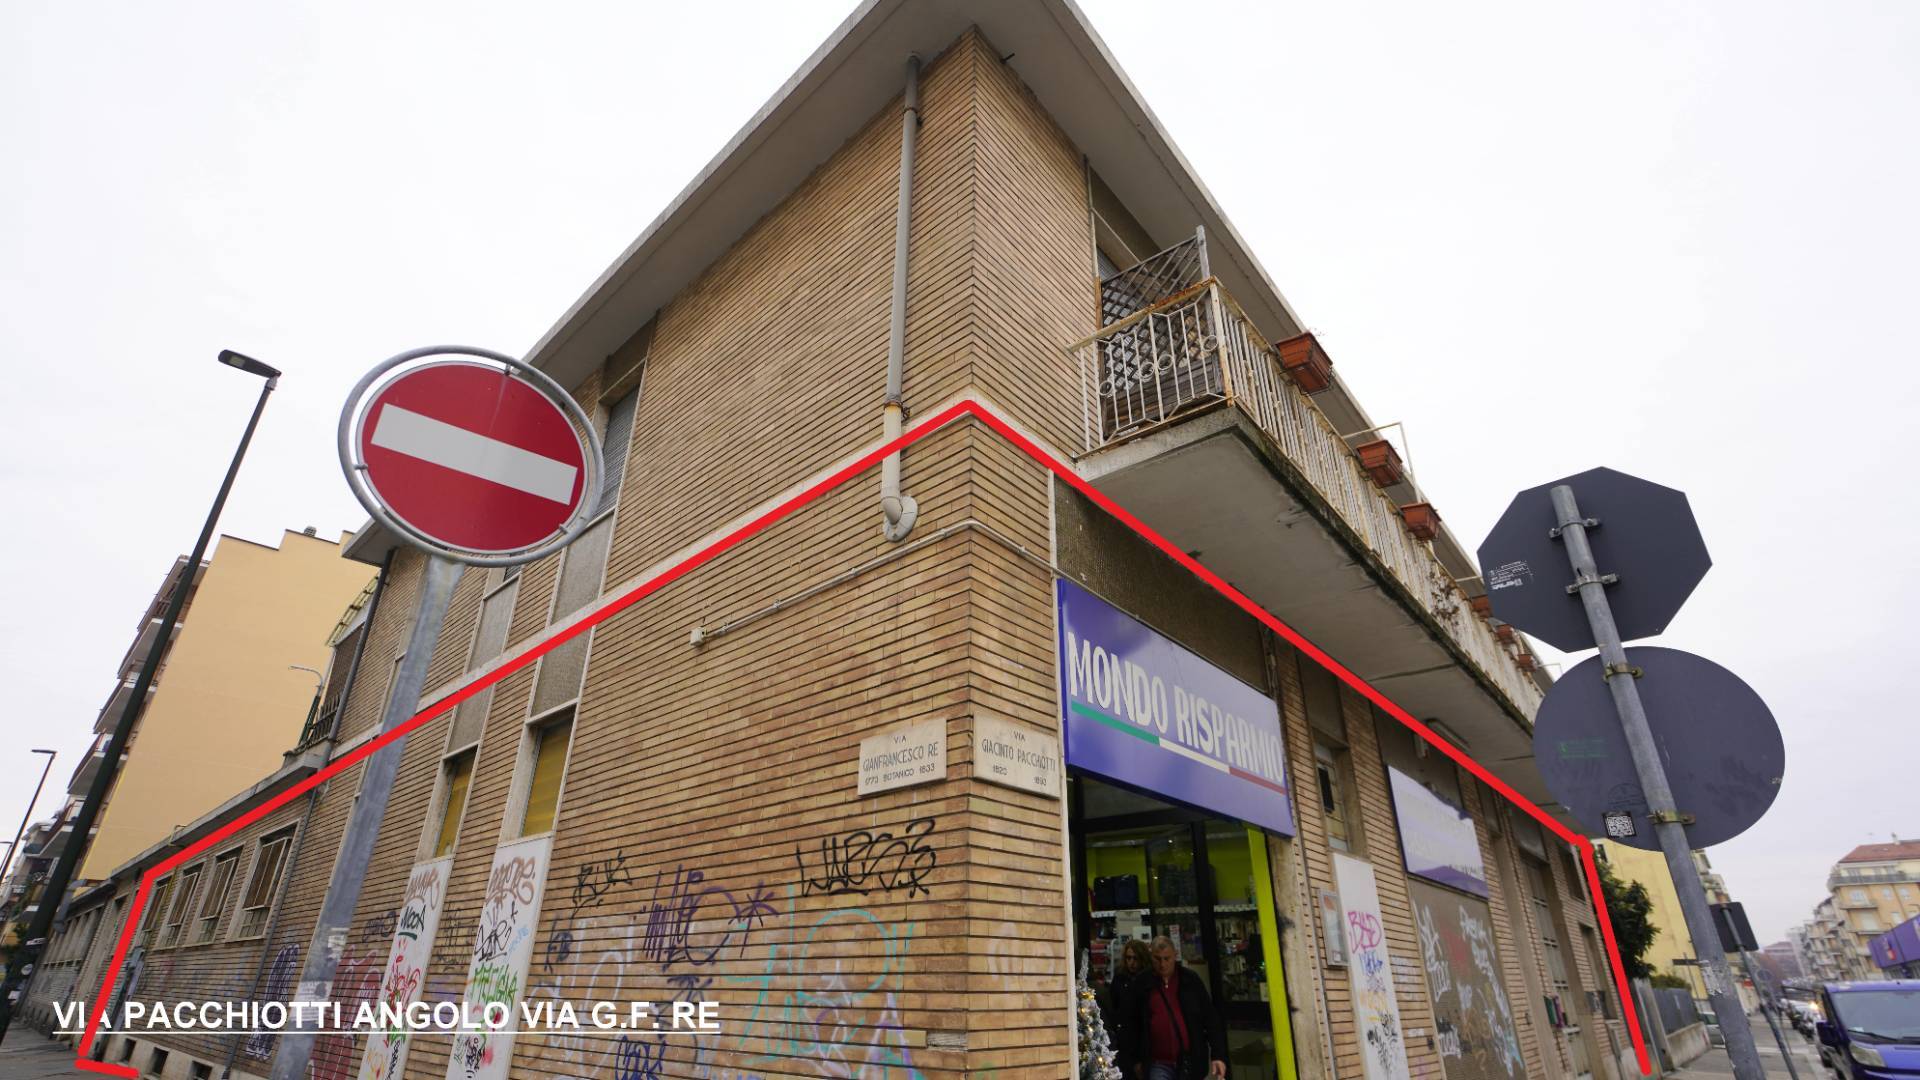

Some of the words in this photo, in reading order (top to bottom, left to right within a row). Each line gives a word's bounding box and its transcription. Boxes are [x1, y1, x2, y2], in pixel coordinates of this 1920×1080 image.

[1068, 631, 1169, 734] MONDO
[1174, 684, 1284, 785] RISPARMIO
[893, 735, 907, 745] VIA
[1013, 731, 1026, 742] VIA
[863, 745, 924, 772] GIANFRANCESCO
[928, 741, 939, 757] RE
[981, 738, 1014, 760] GIACINTO
[1017, 748, 1056, 772] PACCHIOTTI
